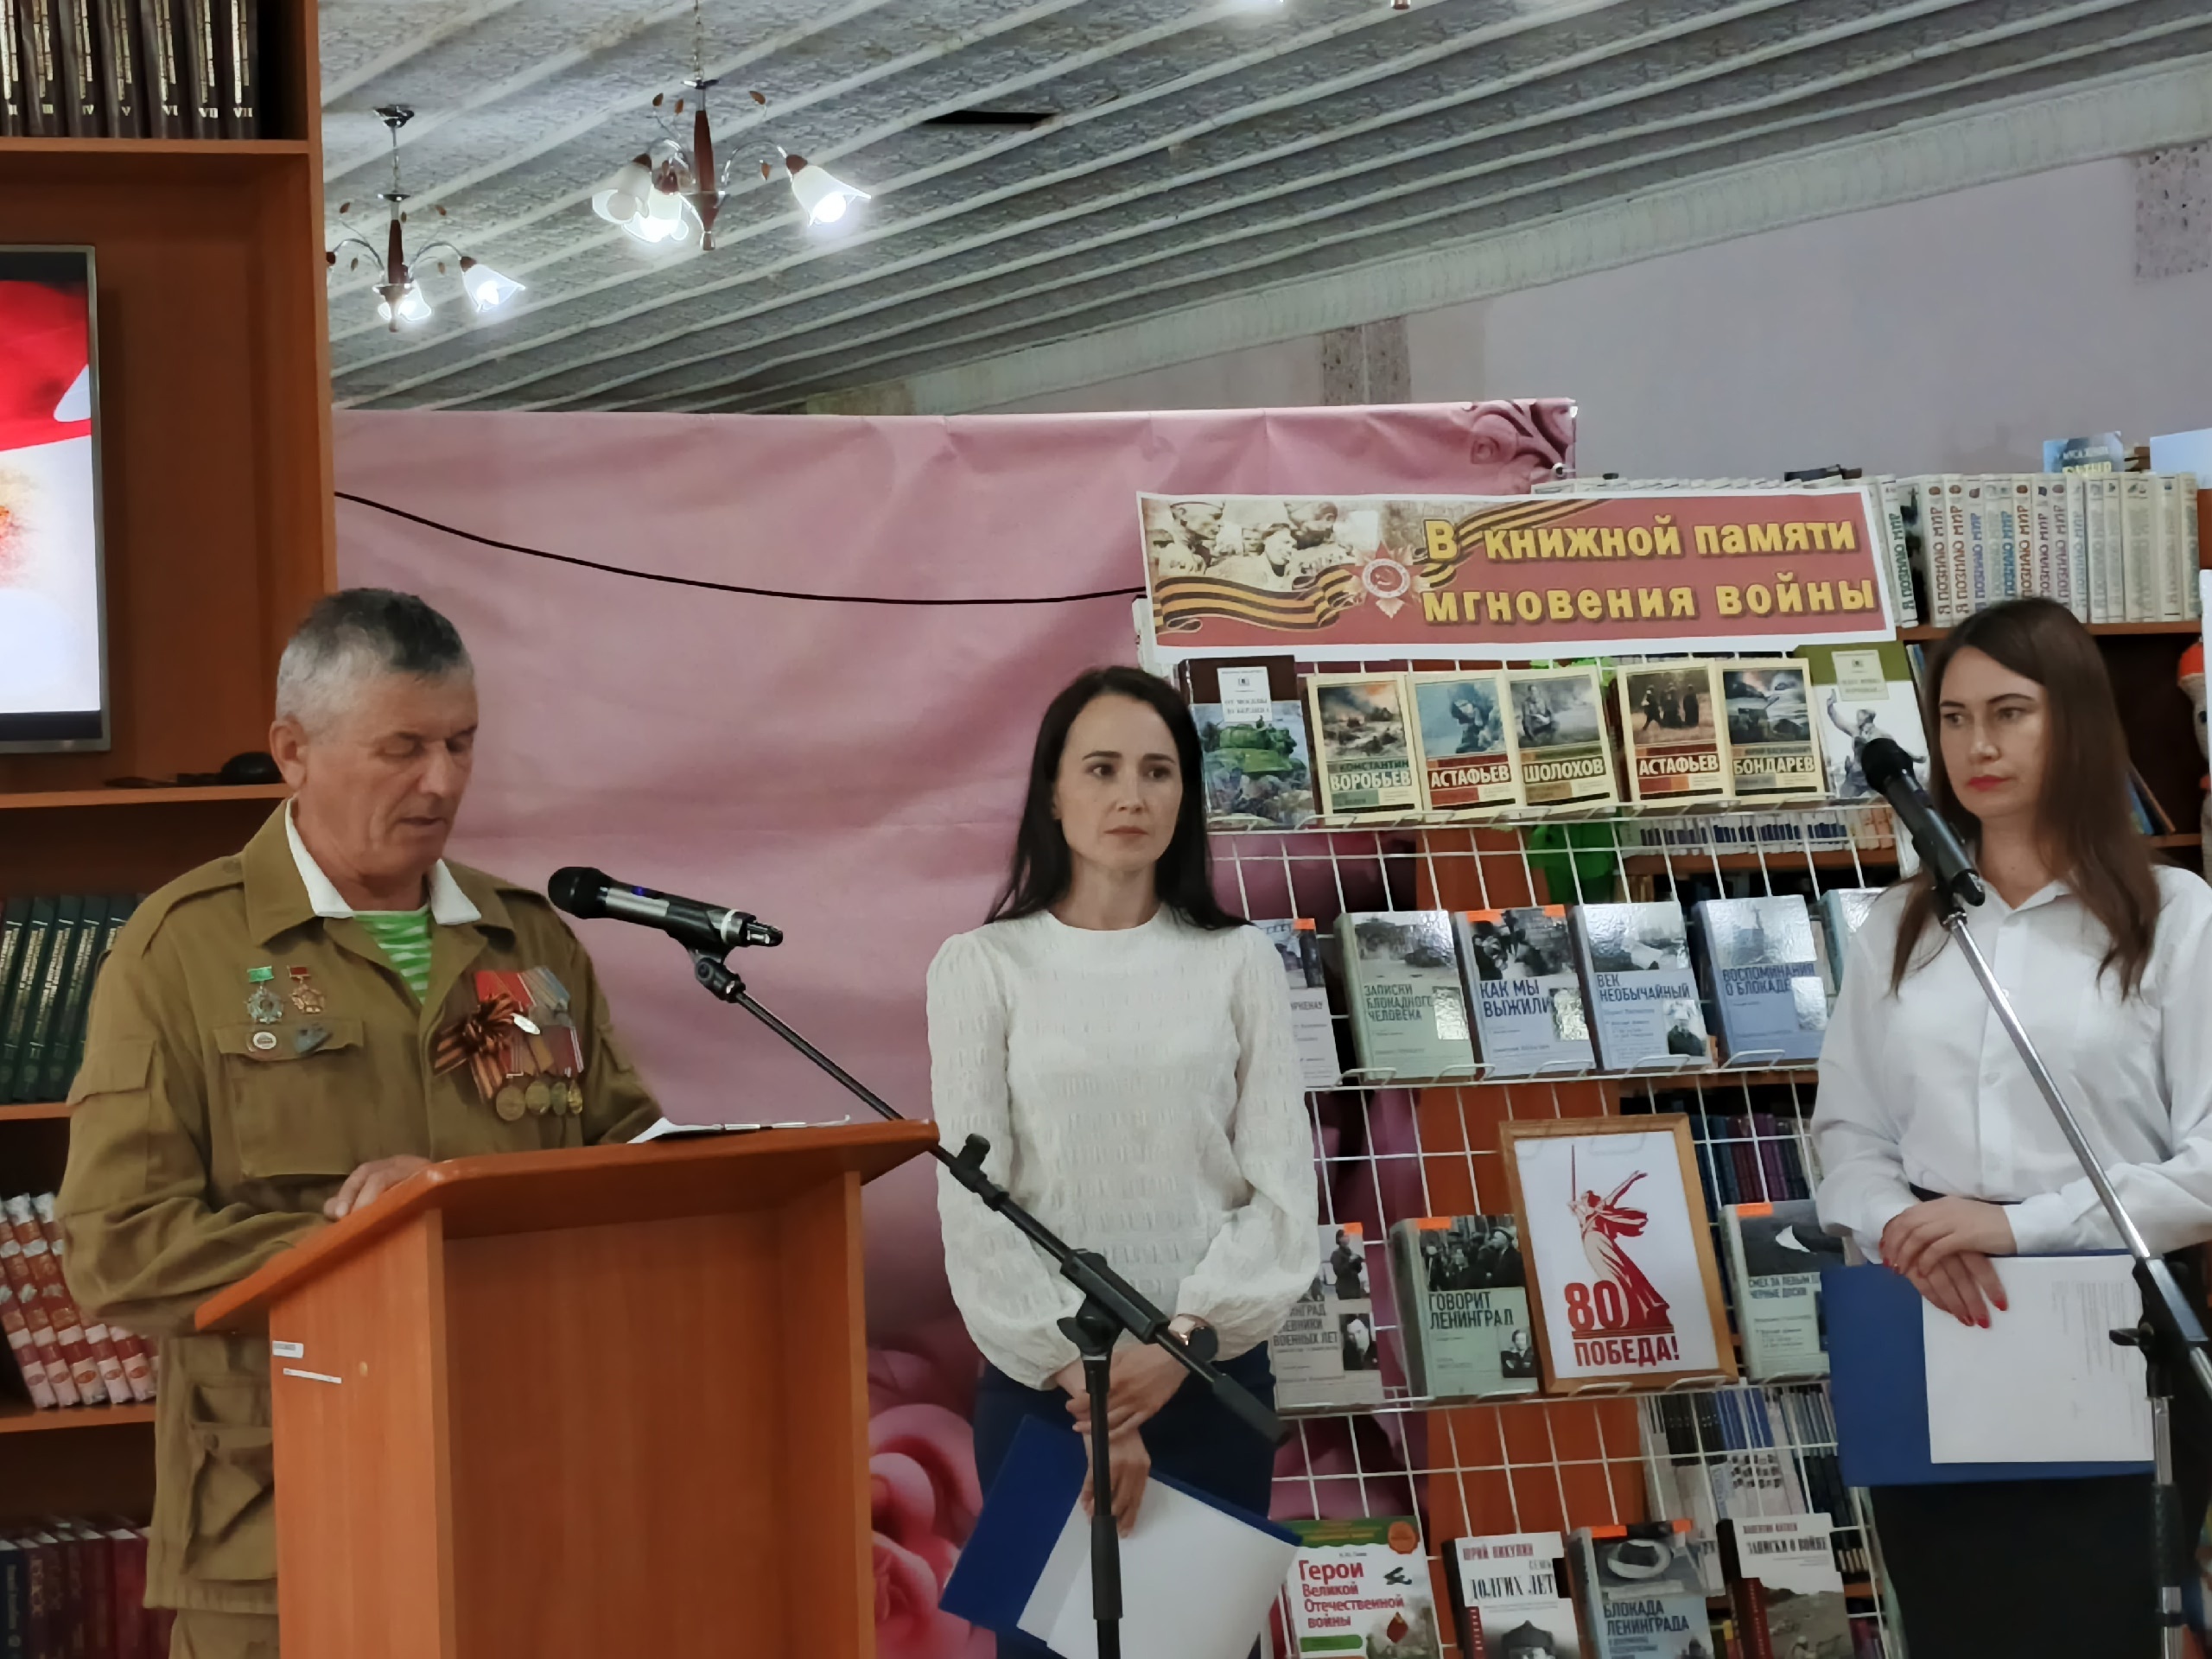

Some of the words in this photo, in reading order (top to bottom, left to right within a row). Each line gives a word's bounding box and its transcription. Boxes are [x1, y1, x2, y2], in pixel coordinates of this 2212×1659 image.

[1889, 513, 1904, 540] МИР
[1930, 506, 1945, 537] МИР
[1949, 505, 1964, 535] МИР
[1970, 512, 1982, 540] МИР
[2017, 505, 2030, 536] МИР
[2037, 513, 2049, 540] МИР
[2053, 505, 2066, 536] МИР
[1424, 519, 1459, 561] В
[1484, 514, 1682, 560] книжной
[1694, 520, 1857, 556] памяти
[1422, 585, 1695, 623] мгновения
[1716, 571, 1875, 616] войны
[1431, 764, 1510, 788] АСТАФЬЕВ
[1523, 758, 1605, 783] ШОЛОХОВ
[1639, 754, 1719, 776] АСТАФЬЕВ
[1733, 756, 1815, 775] БОНДАРЕВ
[1331, 770, 1412, 791] ВОРОБЬЕВ
[1597, 973, 1620, 988] ВЕК
[1722, 963, 1815, 982] ВОСПОМИНАНИЯ
[1364, 983, 1414, 997] ЗАПИСКИ
[1480, 980, 1510, 999] КАК
[1513, 978, 1540, 996] МЫ
[1599, 982, 1691, 1002] НЕОБЫЧАЙНЫЙ
[1725, 983, 1734, 996] О
[1736, 978, 1792, 995] БЛОКАДЕ
[1368, 1009, 1423, 1022] ЧЕЛОВЕКА
[1428, 1291, 1491, 1311] ГОВОРИТ
[1564, 1280, 1625, 1332] 80
[1430, 1308, 1515, 1330] ЛЕНИНГРАД
[1573, 1335, 1680, 1368] ПОБЕДА!
[1298, 1559, 1364, 1586] Герои
[1301, 1580, 1359, 1598] Великой
[1529, 1573, 1554, 1595] ЛЕТ
[1304, 1593, 1405, 1613] Отечественной
[1603, 1599, 1665, 1618] БЛОКАДА
[1606, 1615, 1691, 1637] ЛЕНИНГРАДА
